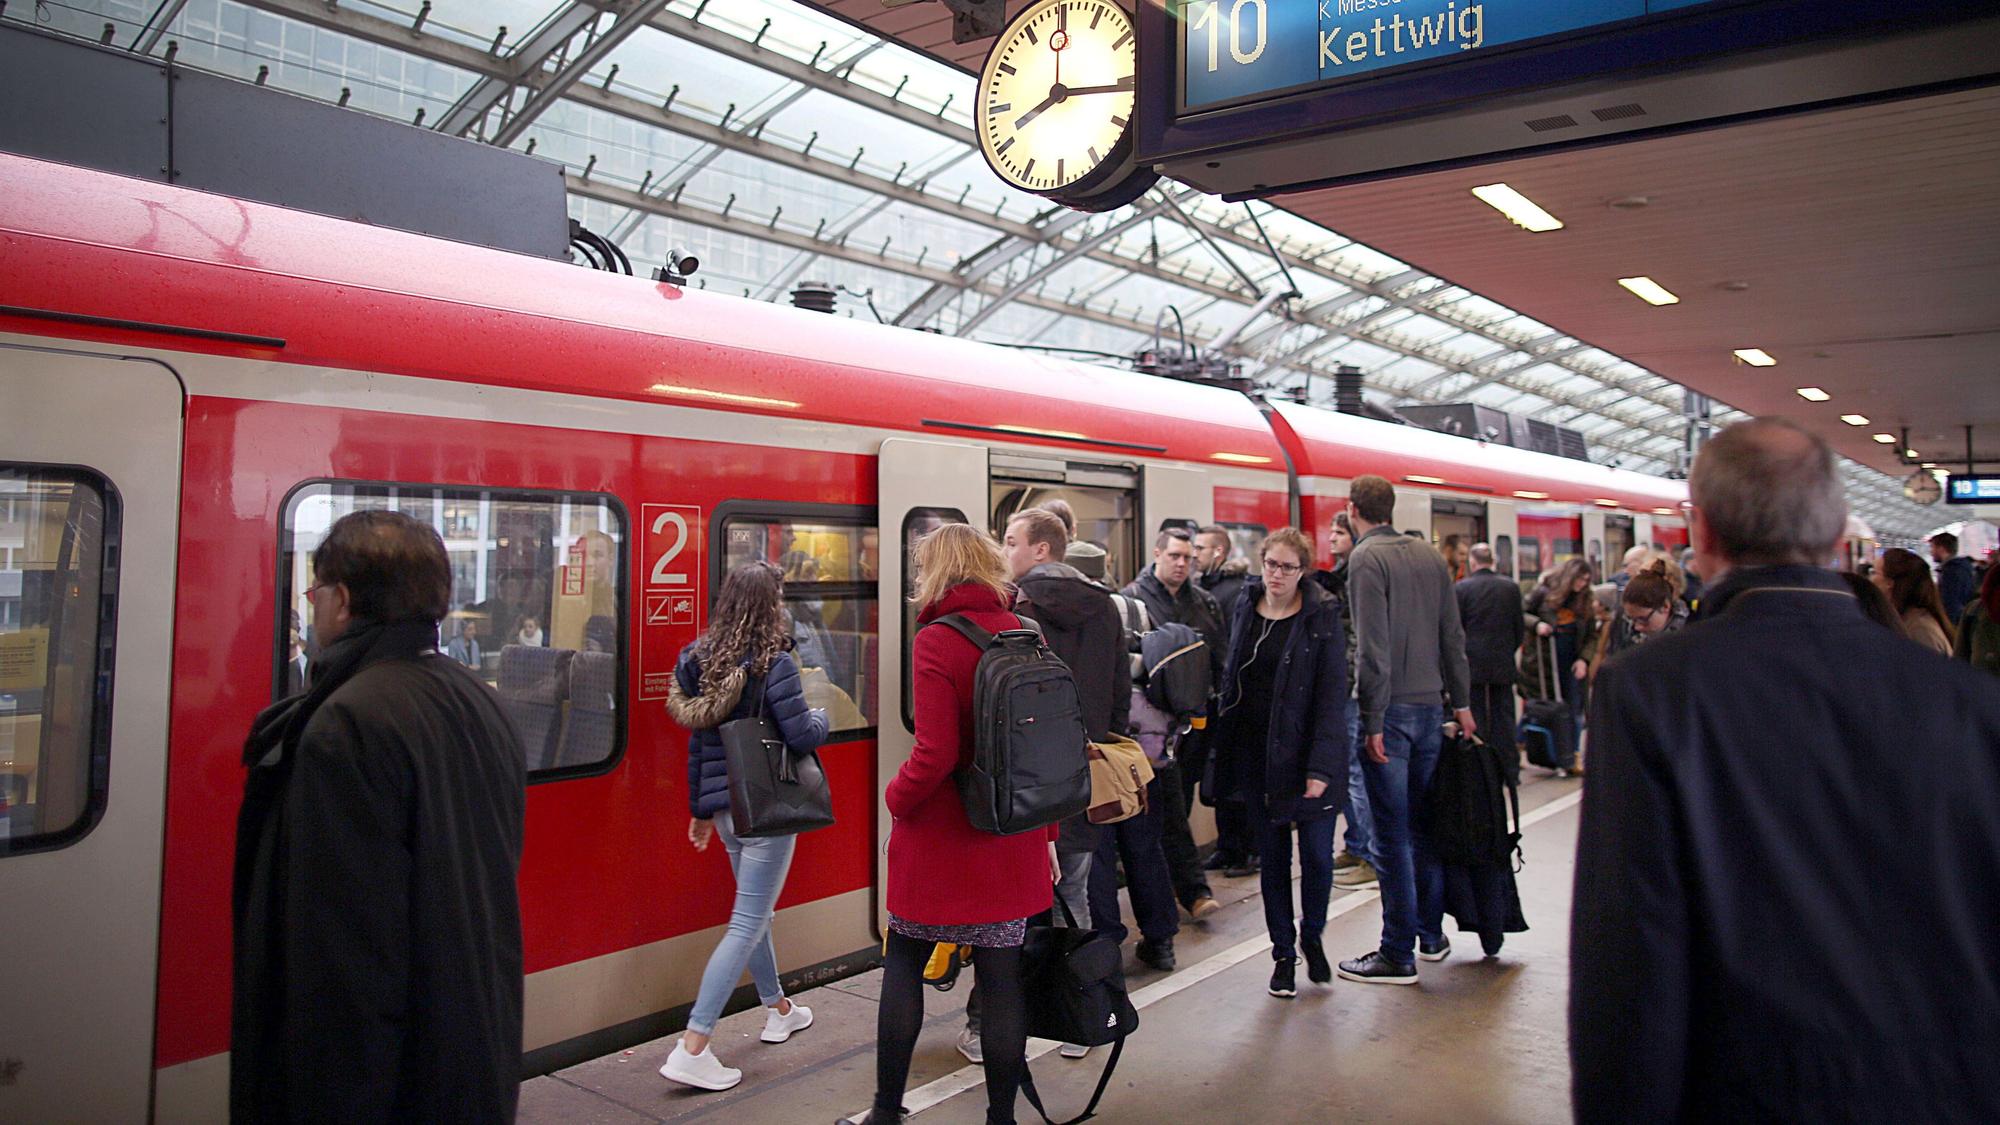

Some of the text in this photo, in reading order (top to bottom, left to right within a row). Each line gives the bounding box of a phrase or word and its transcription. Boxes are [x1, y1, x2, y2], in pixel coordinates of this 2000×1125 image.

[1192, 0, 1267, 72] 10
[1319, 0, 1331, 21] K
[1319, 1, 1483, 69] Kettwig
[650, 511, 688, 584] 2
